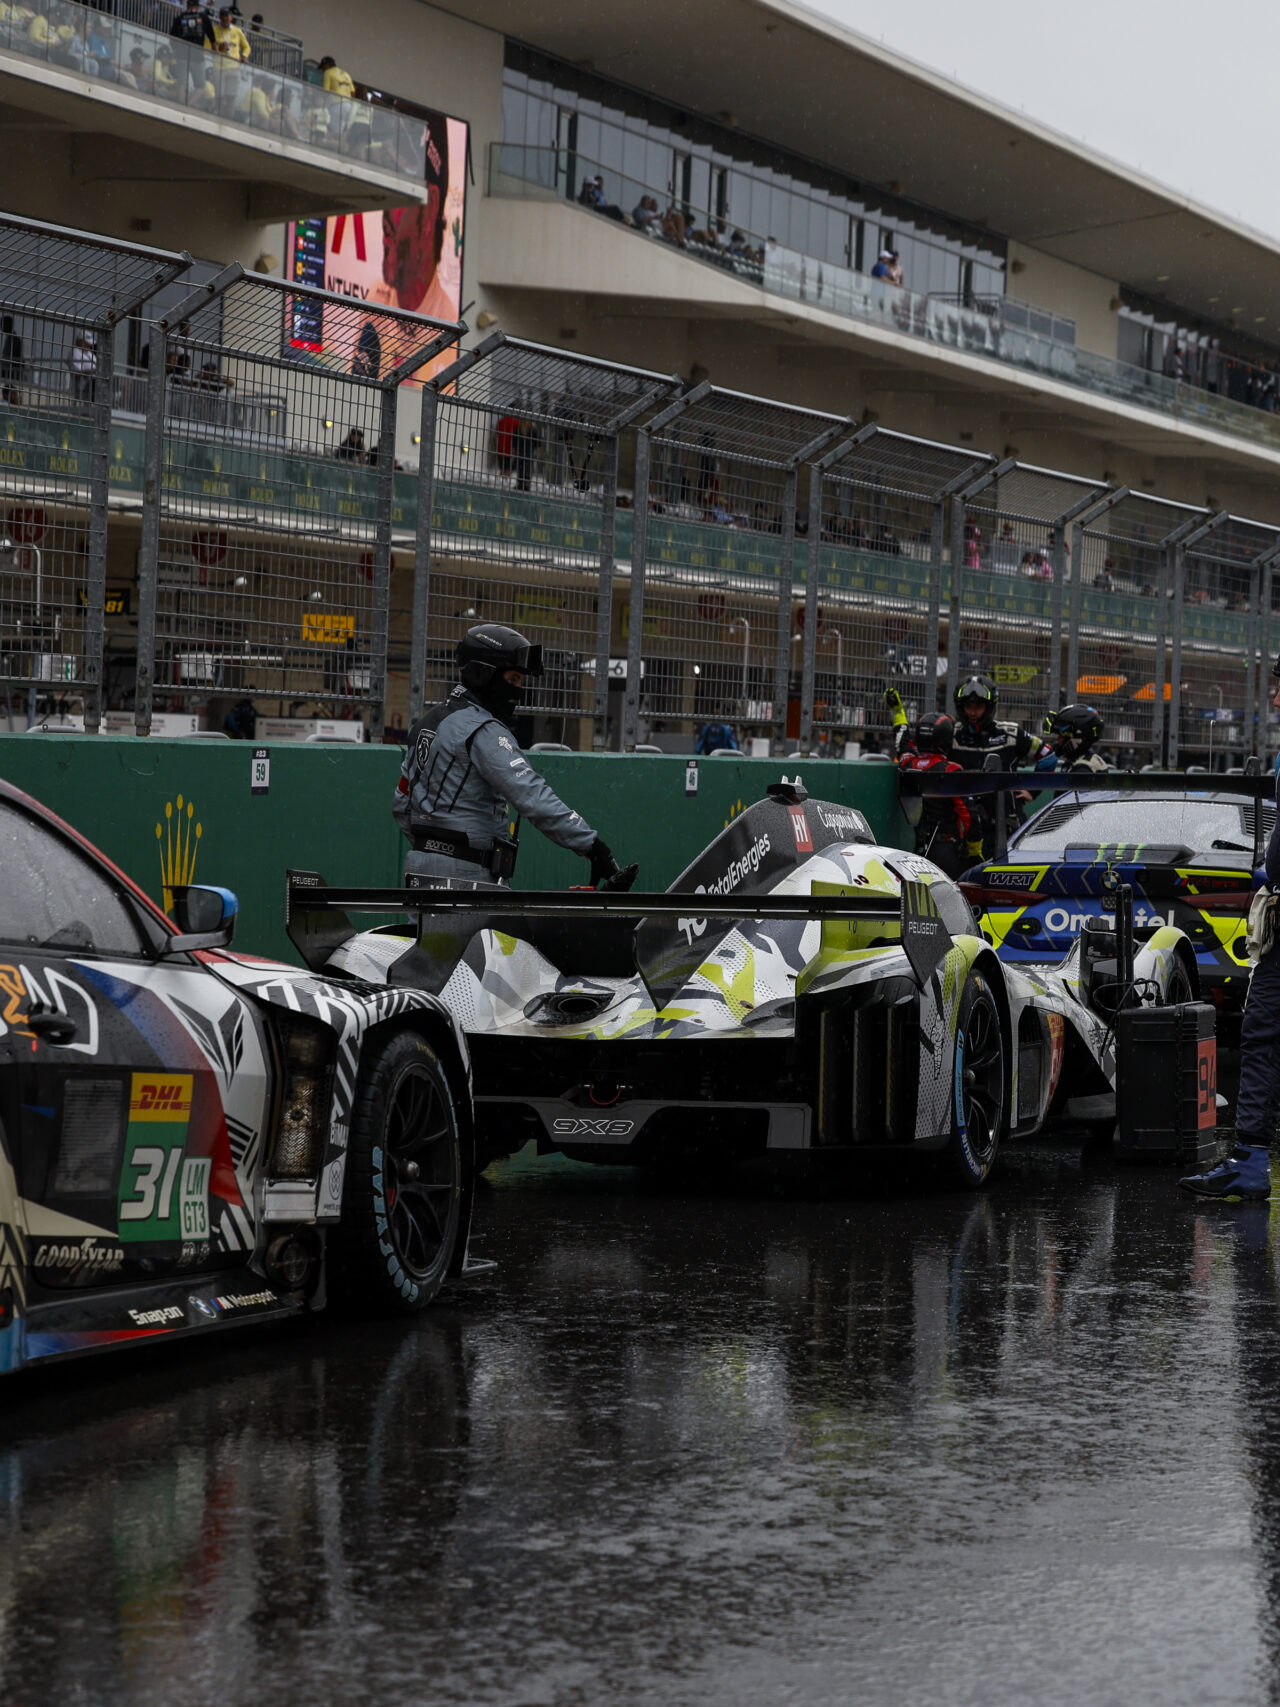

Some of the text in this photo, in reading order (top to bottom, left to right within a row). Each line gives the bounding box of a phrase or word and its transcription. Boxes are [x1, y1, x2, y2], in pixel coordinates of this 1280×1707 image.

[105, 599, 125, 613] 81
[255, 762, 266, 782] 59
[791, 814, 809, 843] HY
[707, 832, 772, 896] TotalEnergies
[292, 876, 319, 886] PEUGEOT
[988, 872, 1036, 887] WRT
[908, 921, 938, 936] PEUGEOT
[1044, 907, 1174, 933] Omatel
[137, 1084, 186, 1111] DHL
[553, 1118, 635, 1136] 9X8
[118, 1145, 185, 1221] 31
[185, 1162, 206, 1196] LM
[183, 1201, 207, 1234] GT3
[371, 1145, 419, 1303] GOODYEAR
[127, 1305, 185, 1326] Snap-on
